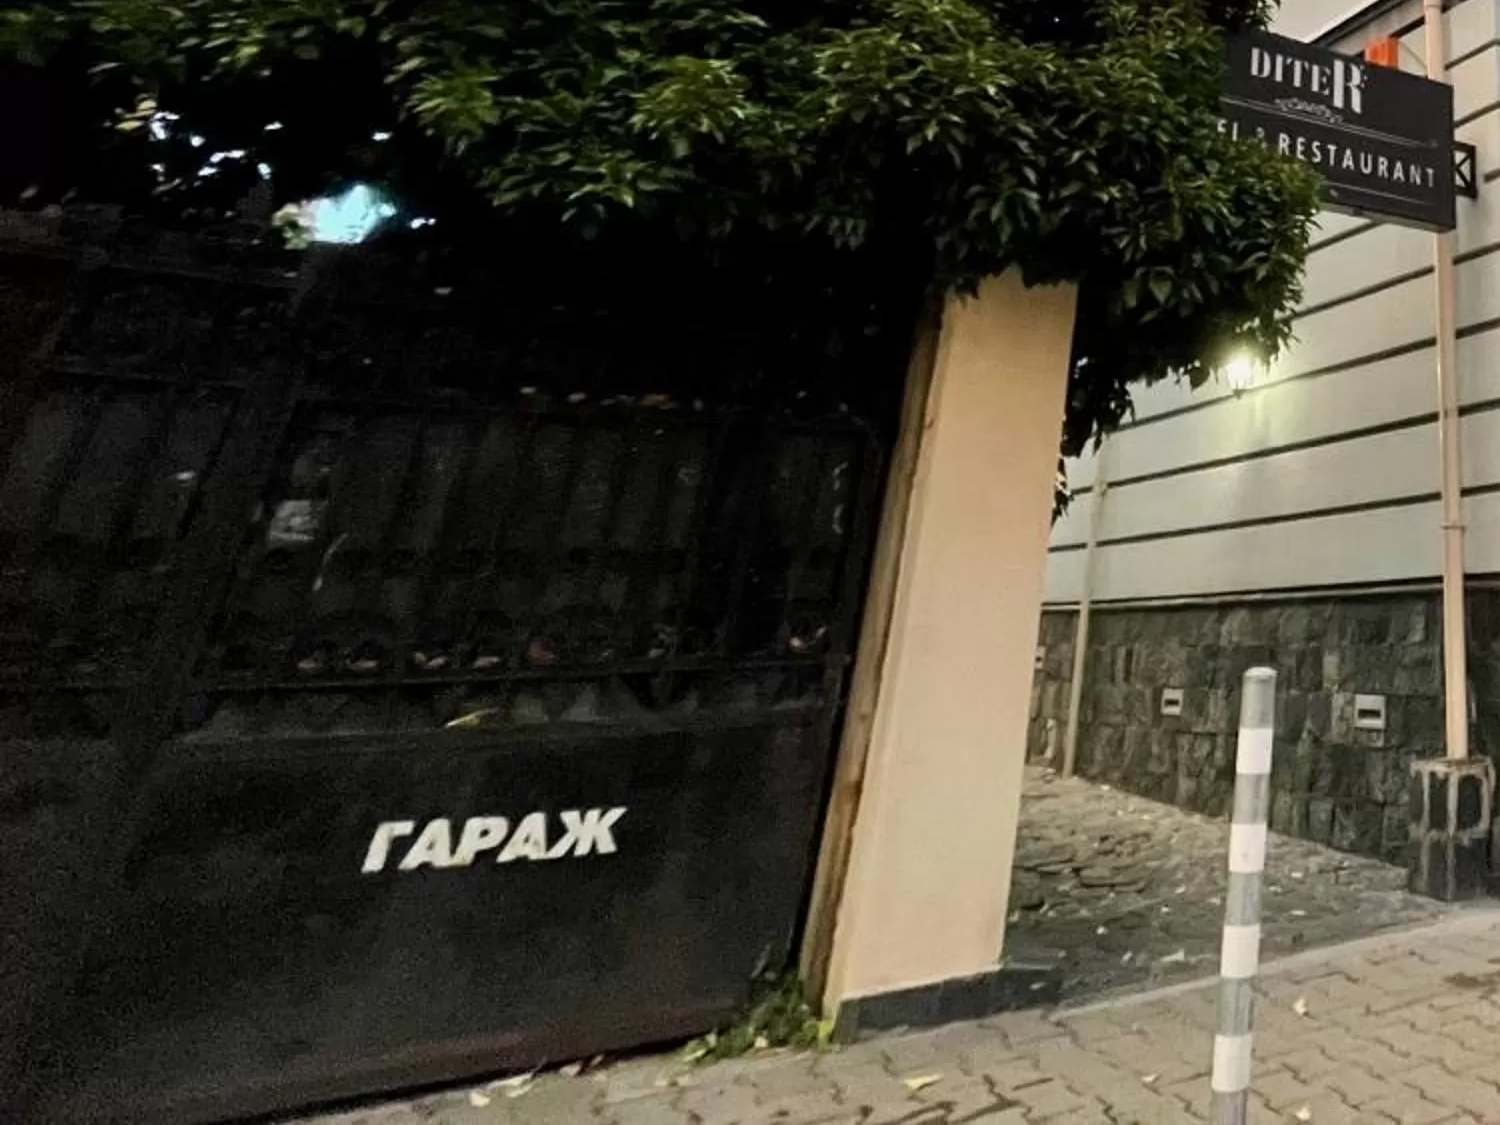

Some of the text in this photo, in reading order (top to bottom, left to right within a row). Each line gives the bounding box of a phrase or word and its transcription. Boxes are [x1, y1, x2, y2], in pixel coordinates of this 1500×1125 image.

[1250, 47, 1367, 114] DITER
[1278, 132, 1436, 188] RESTAURANT
[361, 806, 628, 873] ГАРАЖ
